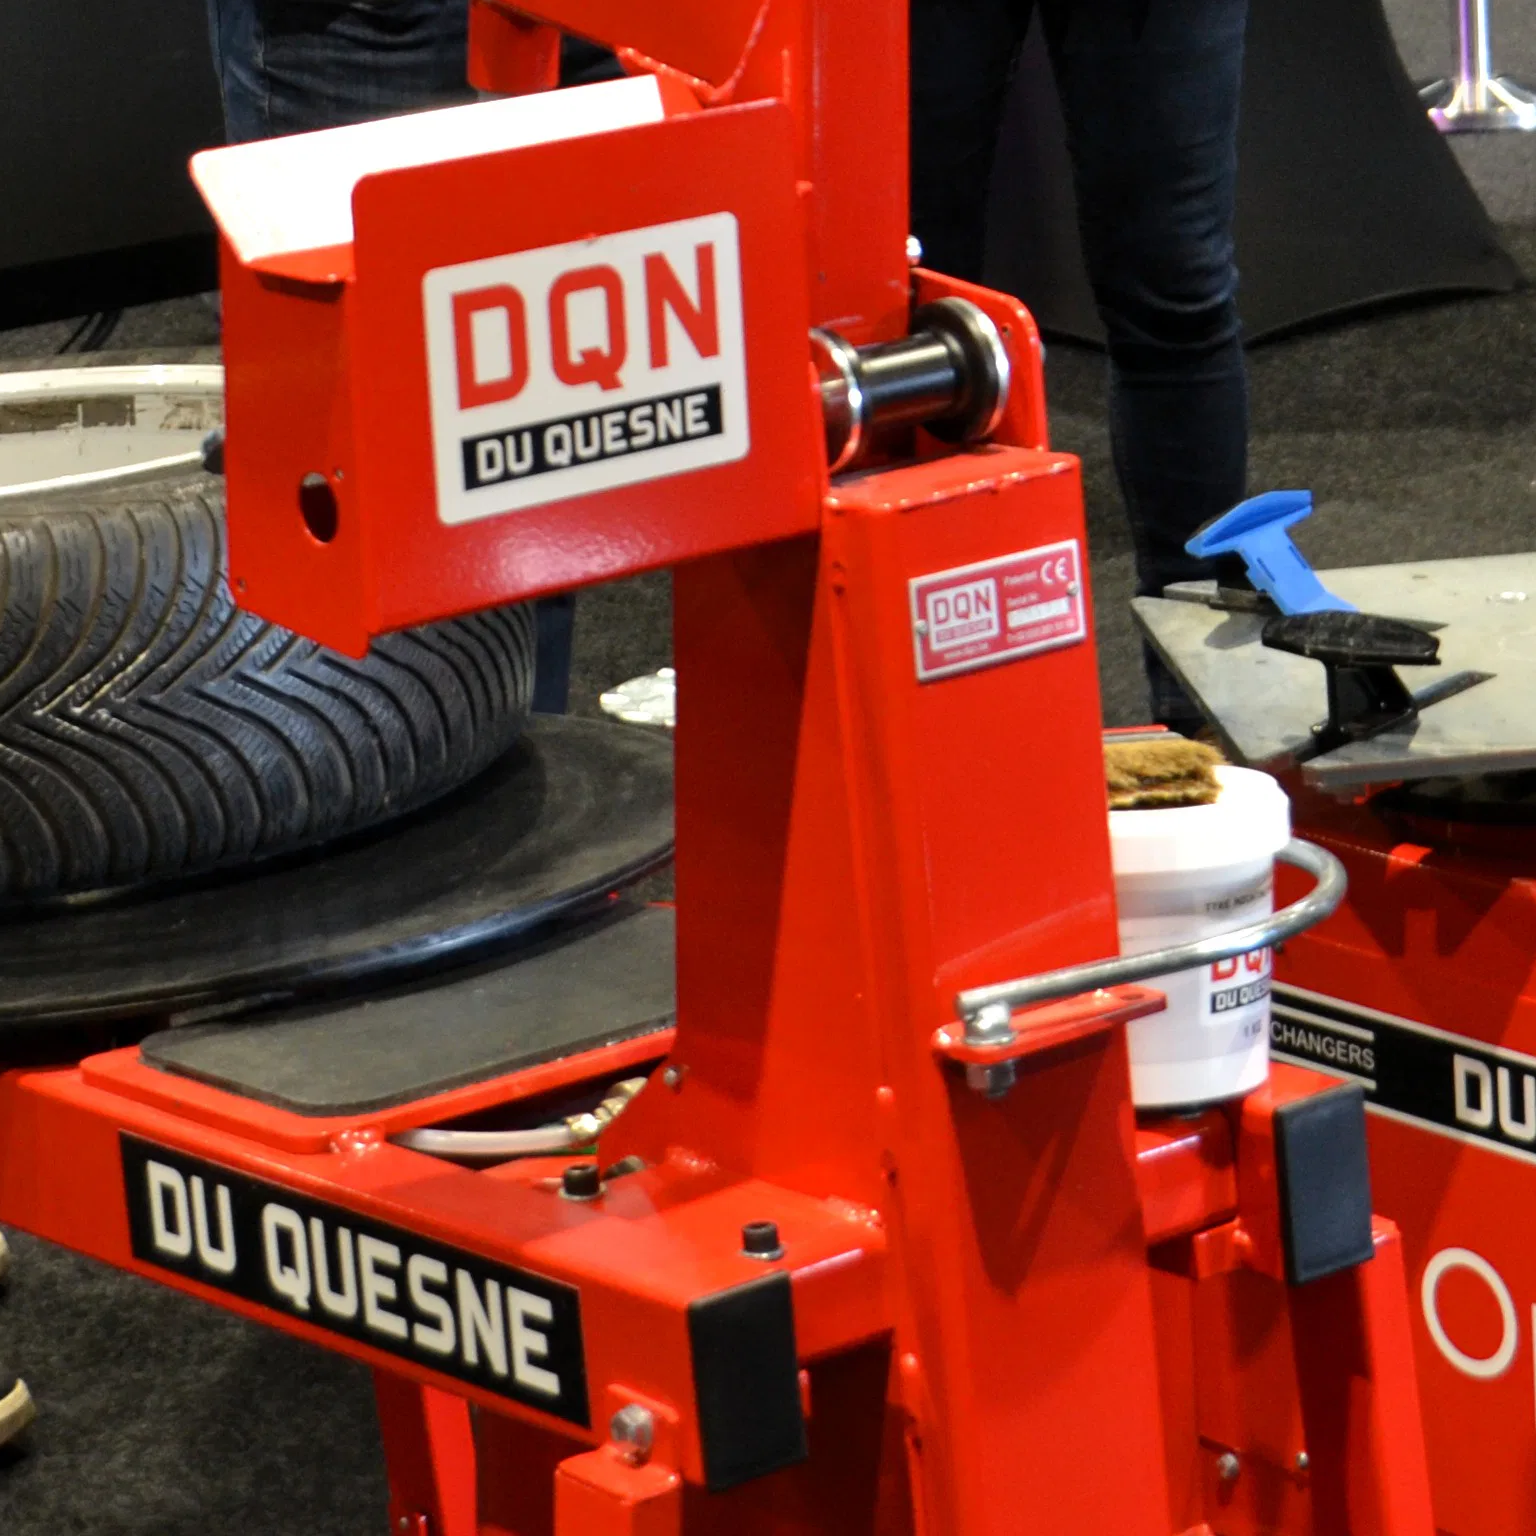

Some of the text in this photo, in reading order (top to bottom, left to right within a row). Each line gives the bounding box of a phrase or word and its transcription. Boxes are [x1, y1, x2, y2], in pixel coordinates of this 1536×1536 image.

[451, 241, 720, 410] DQN
[476, 393, 709, 482] DU QUESNE
[934, 585, 991, 624] DQN
[1215, 989, 1237, 1011] DU
[1270, 1021, 1375, 1069] CHANGERS
[147, 1160, 561, 1396] DU QUESNE
